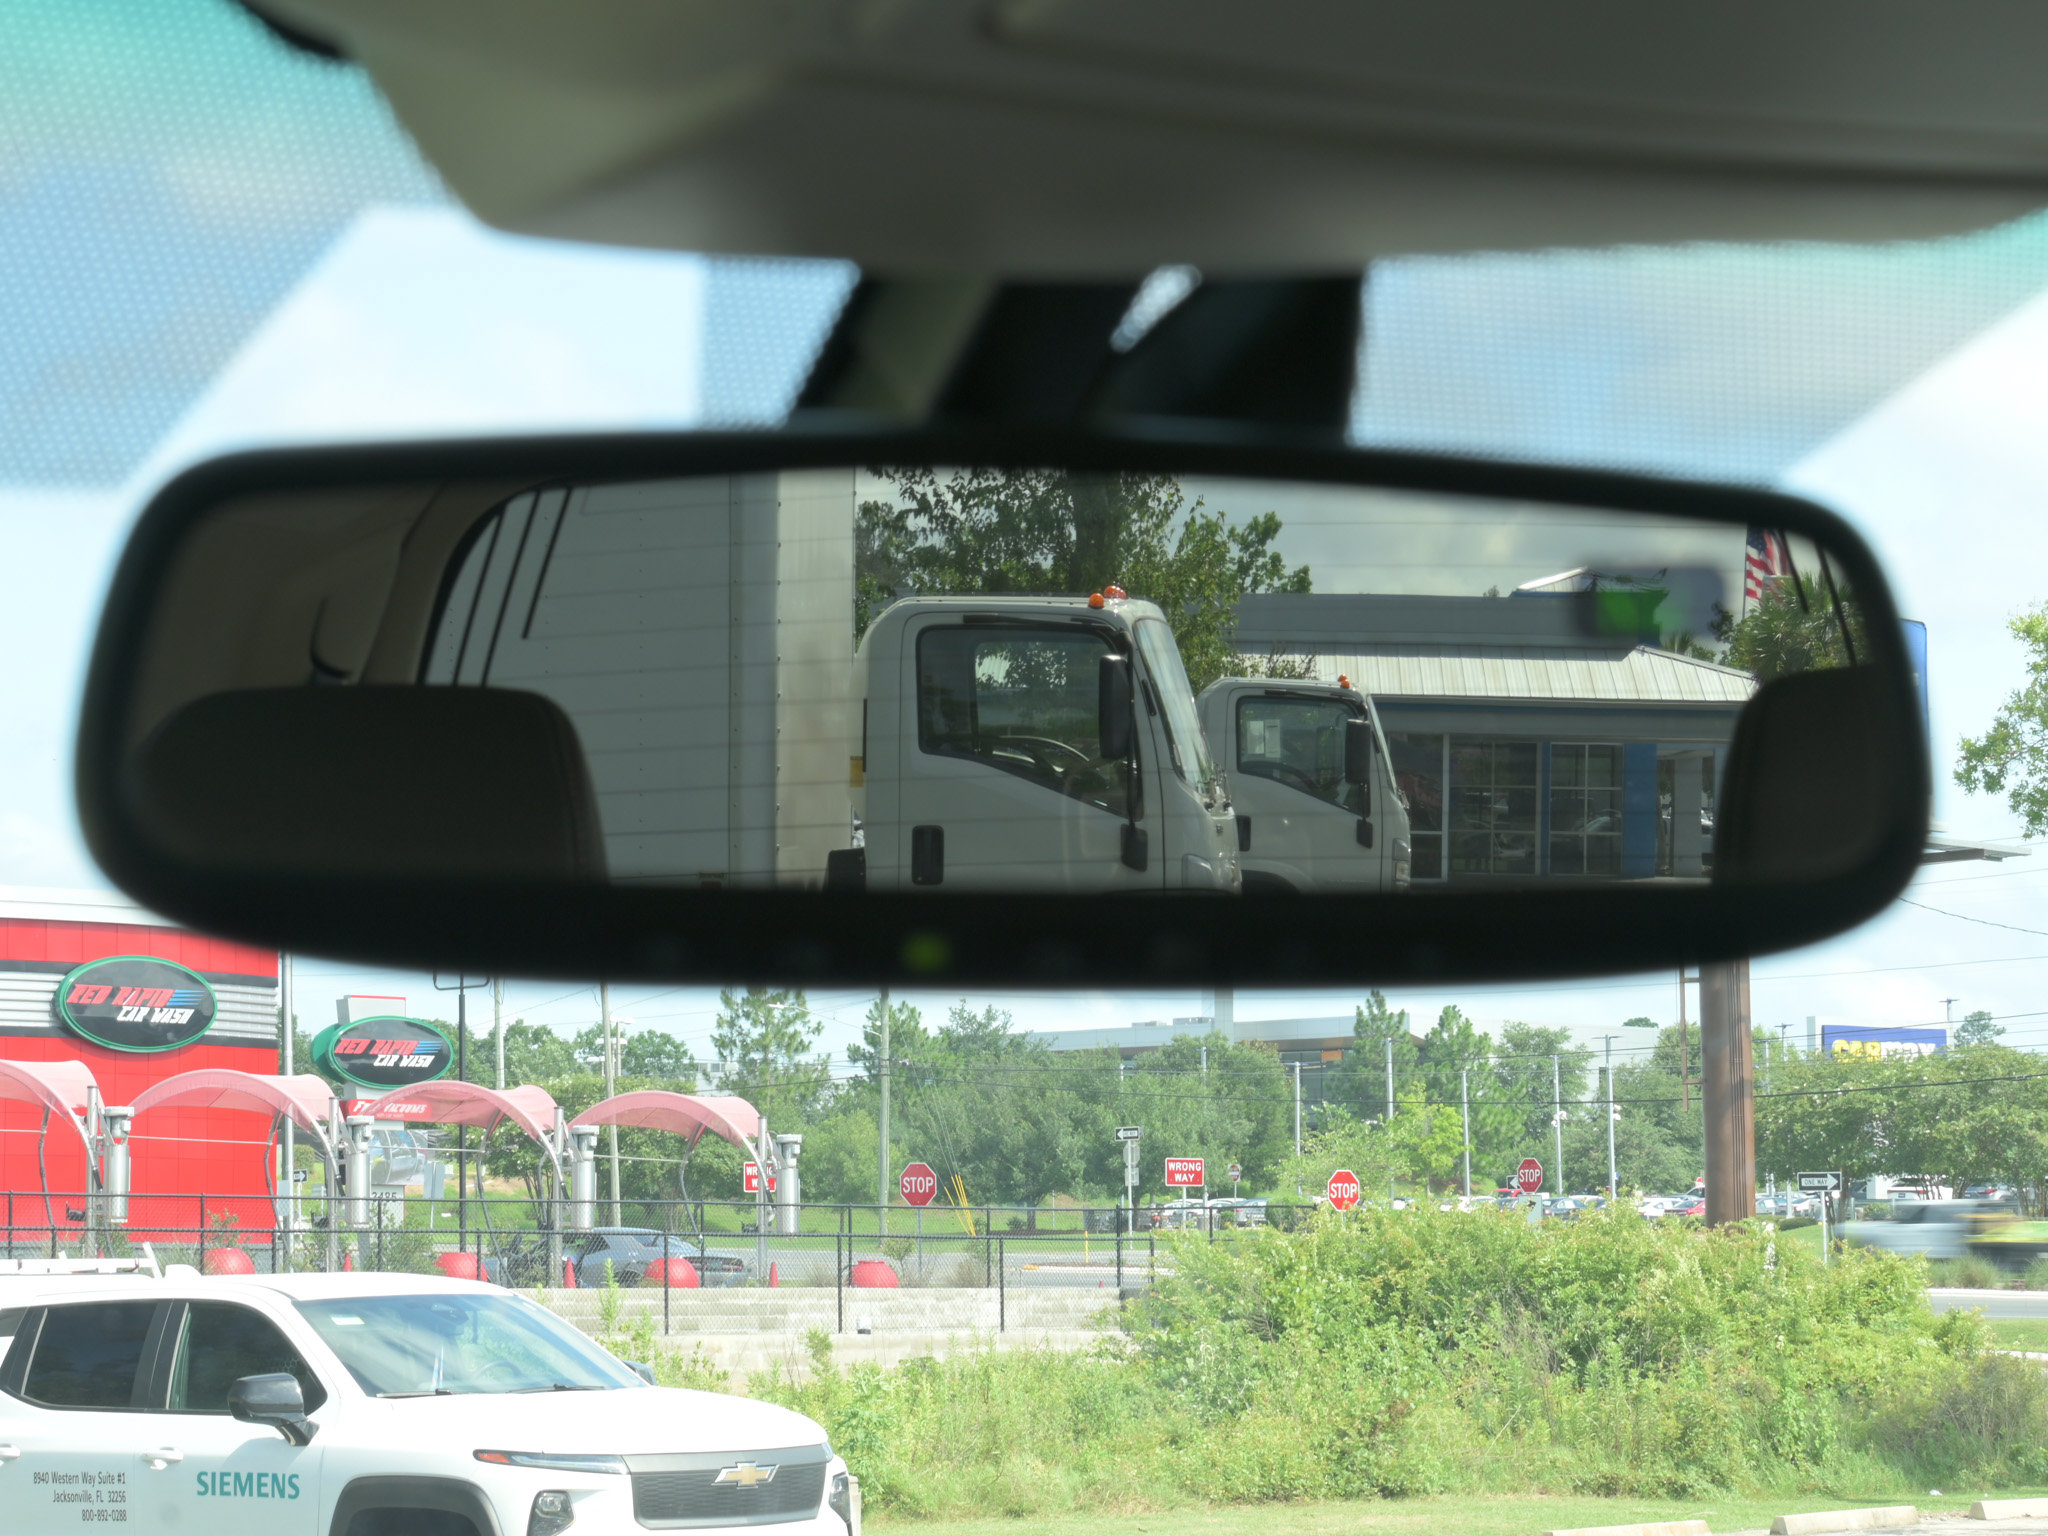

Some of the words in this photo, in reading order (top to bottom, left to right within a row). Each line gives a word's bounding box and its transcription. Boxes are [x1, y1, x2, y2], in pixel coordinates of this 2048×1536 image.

[66, 984, 113, 1005] RED
[111, 986, 175, 1008] RAPID
[116, 1006, 151, 1022] CAR
[150, 1007, 195, 1025] WASH
[334, 1038, 371, 1055] RED
[369, 1039, 419, 1056] RAPID
[373, 1054, 400, 1067] CAR
[399, 1054, 435, 1068] WASH
[1168, 1162, 1202, 1171] WRONG
[1174, 1173, 1195, 1182] WAY
[1519, 1169, 1541, 1182] STOP
[903, 1177, 934, 1193] STOP
[1330, 1183, 1357, 1199] STOP
[33, 1471, 49, 1484] 8940
[51, 1471, 80, 1484] Western
[81, 1471, 96, 1487] Way
[97, 1471, 115, 1484] Suite
[117, 1472, 126, 1484] #1
[196, 1471, 301, 1499] SIEMENS
[53, 1490, 94, 1504] Jacksonville,
[96, 1490, 104, 1503] FL
[107, 1490, 126, 1503] 32256
[81, 1509, 127, 1522] 800-892-0288
